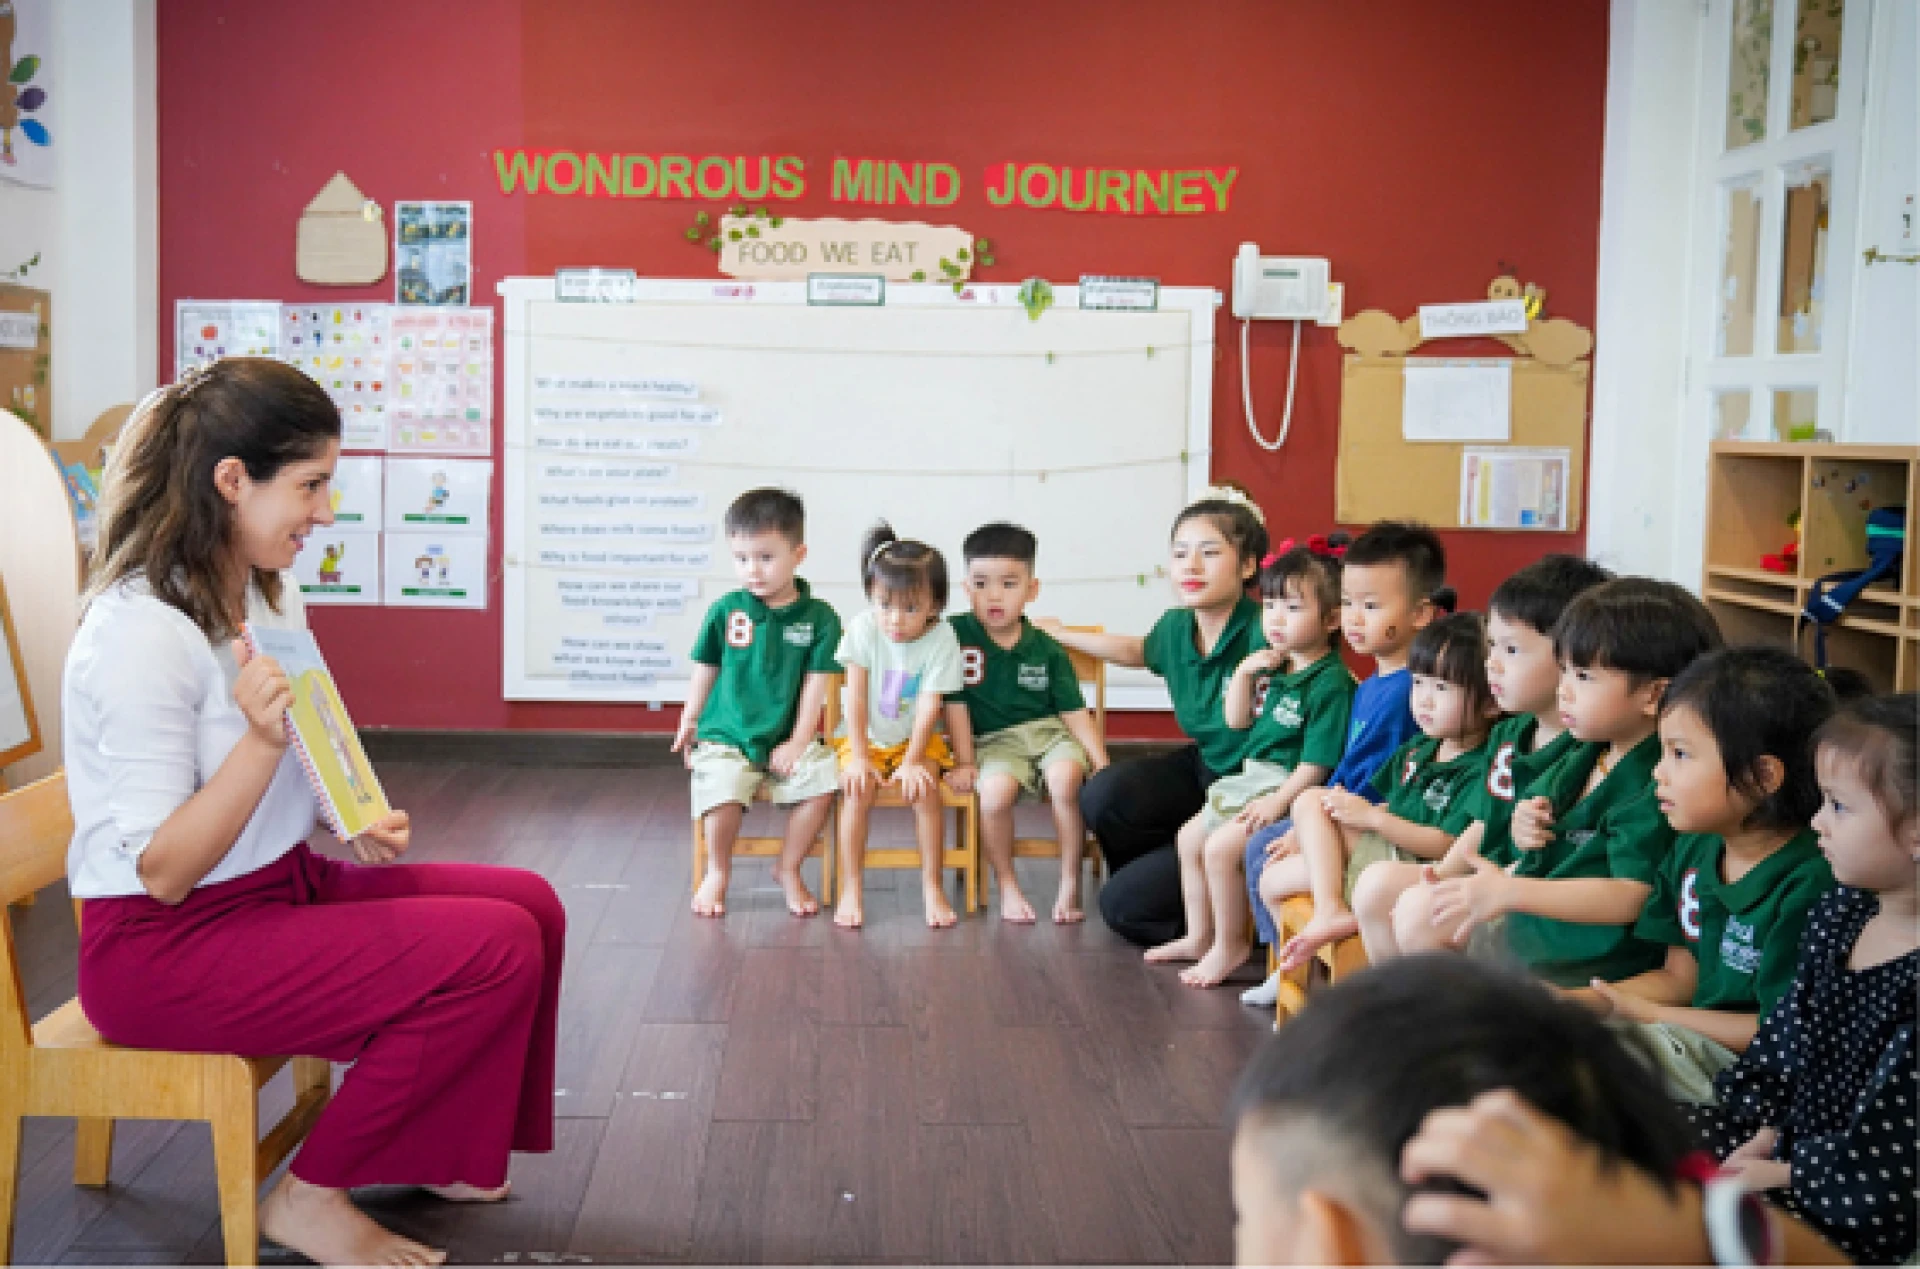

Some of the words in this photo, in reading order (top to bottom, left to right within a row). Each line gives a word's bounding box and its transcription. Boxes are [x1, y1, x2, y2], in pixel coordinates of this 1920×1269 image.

[494, 149, 806, 198] WONDROUS
[832, 158, 961, 206] MIND
[987, 163, 1239, 213] JOURNEY
[738, 240, 807, 265] FOOD
[820, 241, 859, 264] WE
[870, 240, 920, 265] EAT
[535, 377, 566, 389] Wat
[585, 408, 644, 422] vegetabes
